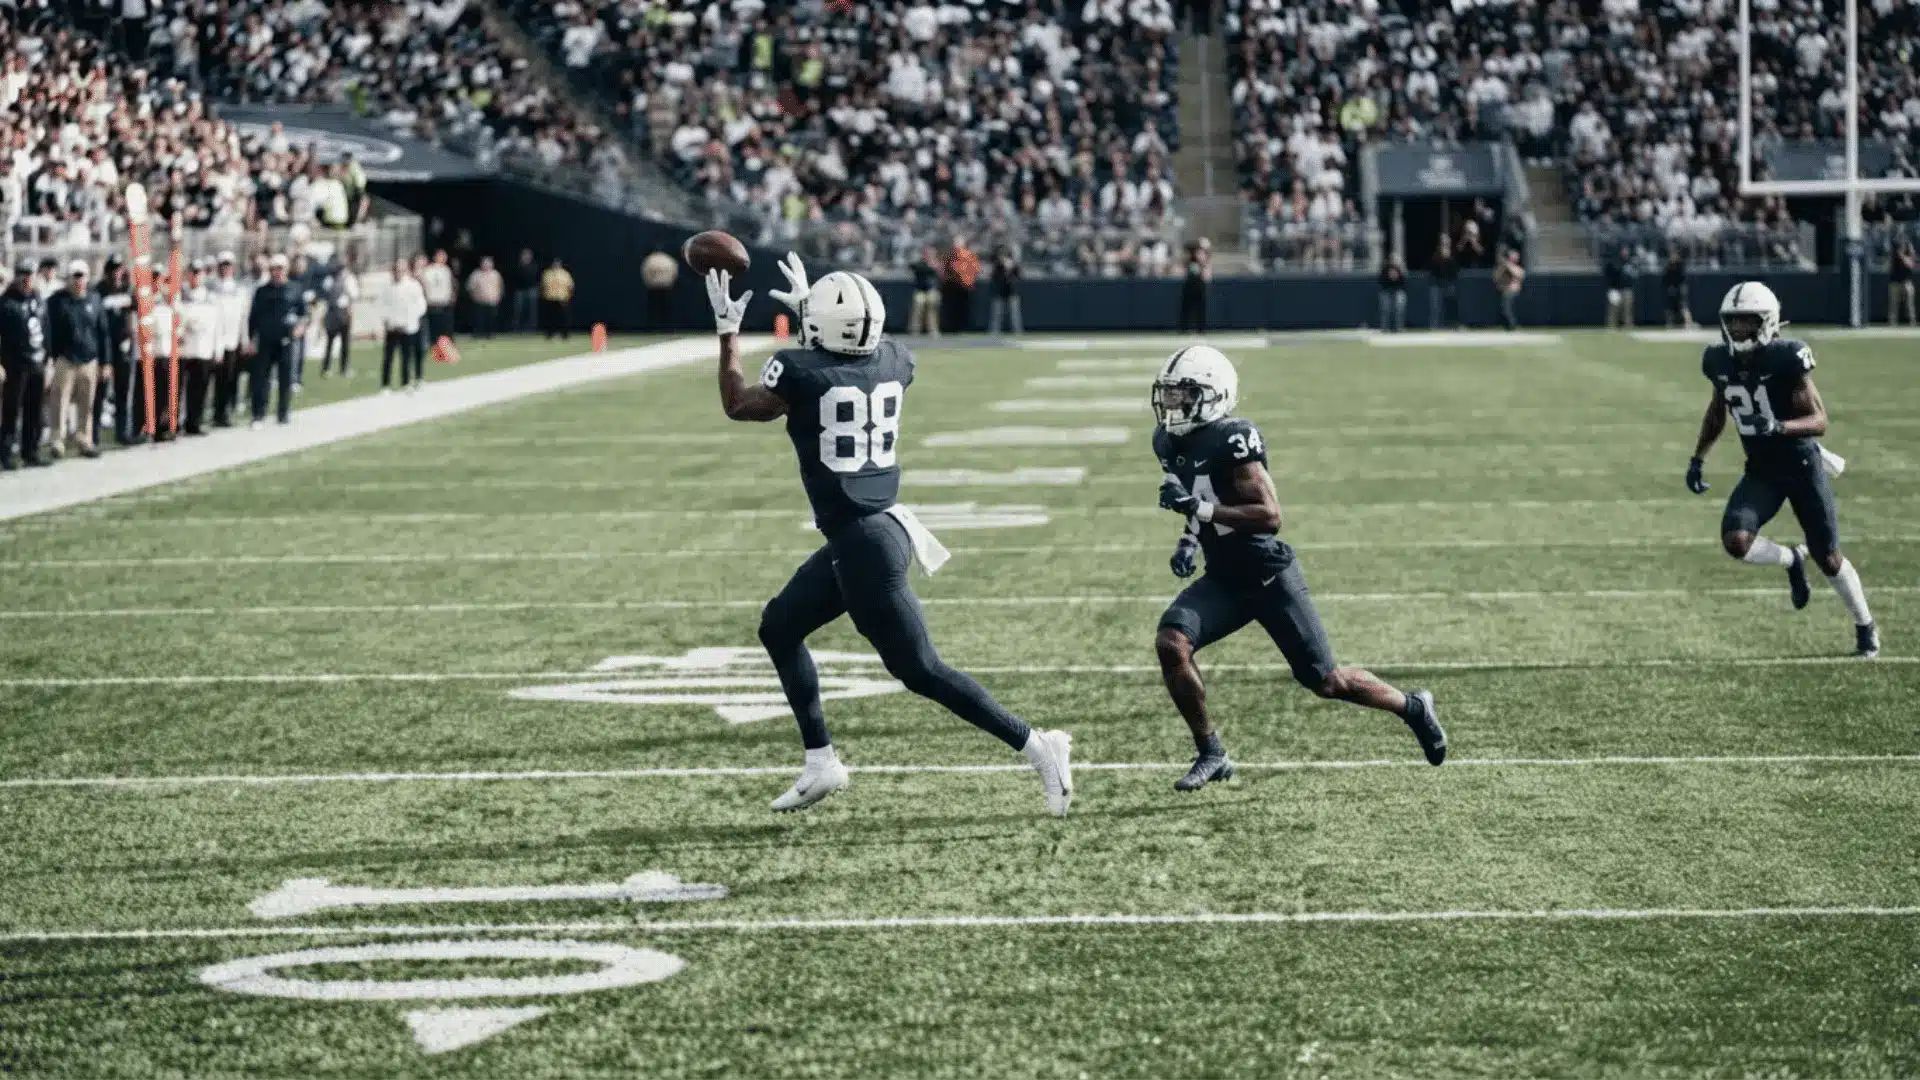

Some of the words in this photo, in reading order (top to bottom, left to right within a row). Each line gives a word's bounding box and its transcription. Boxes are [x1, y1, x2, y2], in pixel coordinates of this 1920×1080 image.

[819, 381, 903, 472] 88
[1724, 385, 1775, 436] 21
[1227, 427, 1262, 459] 34
